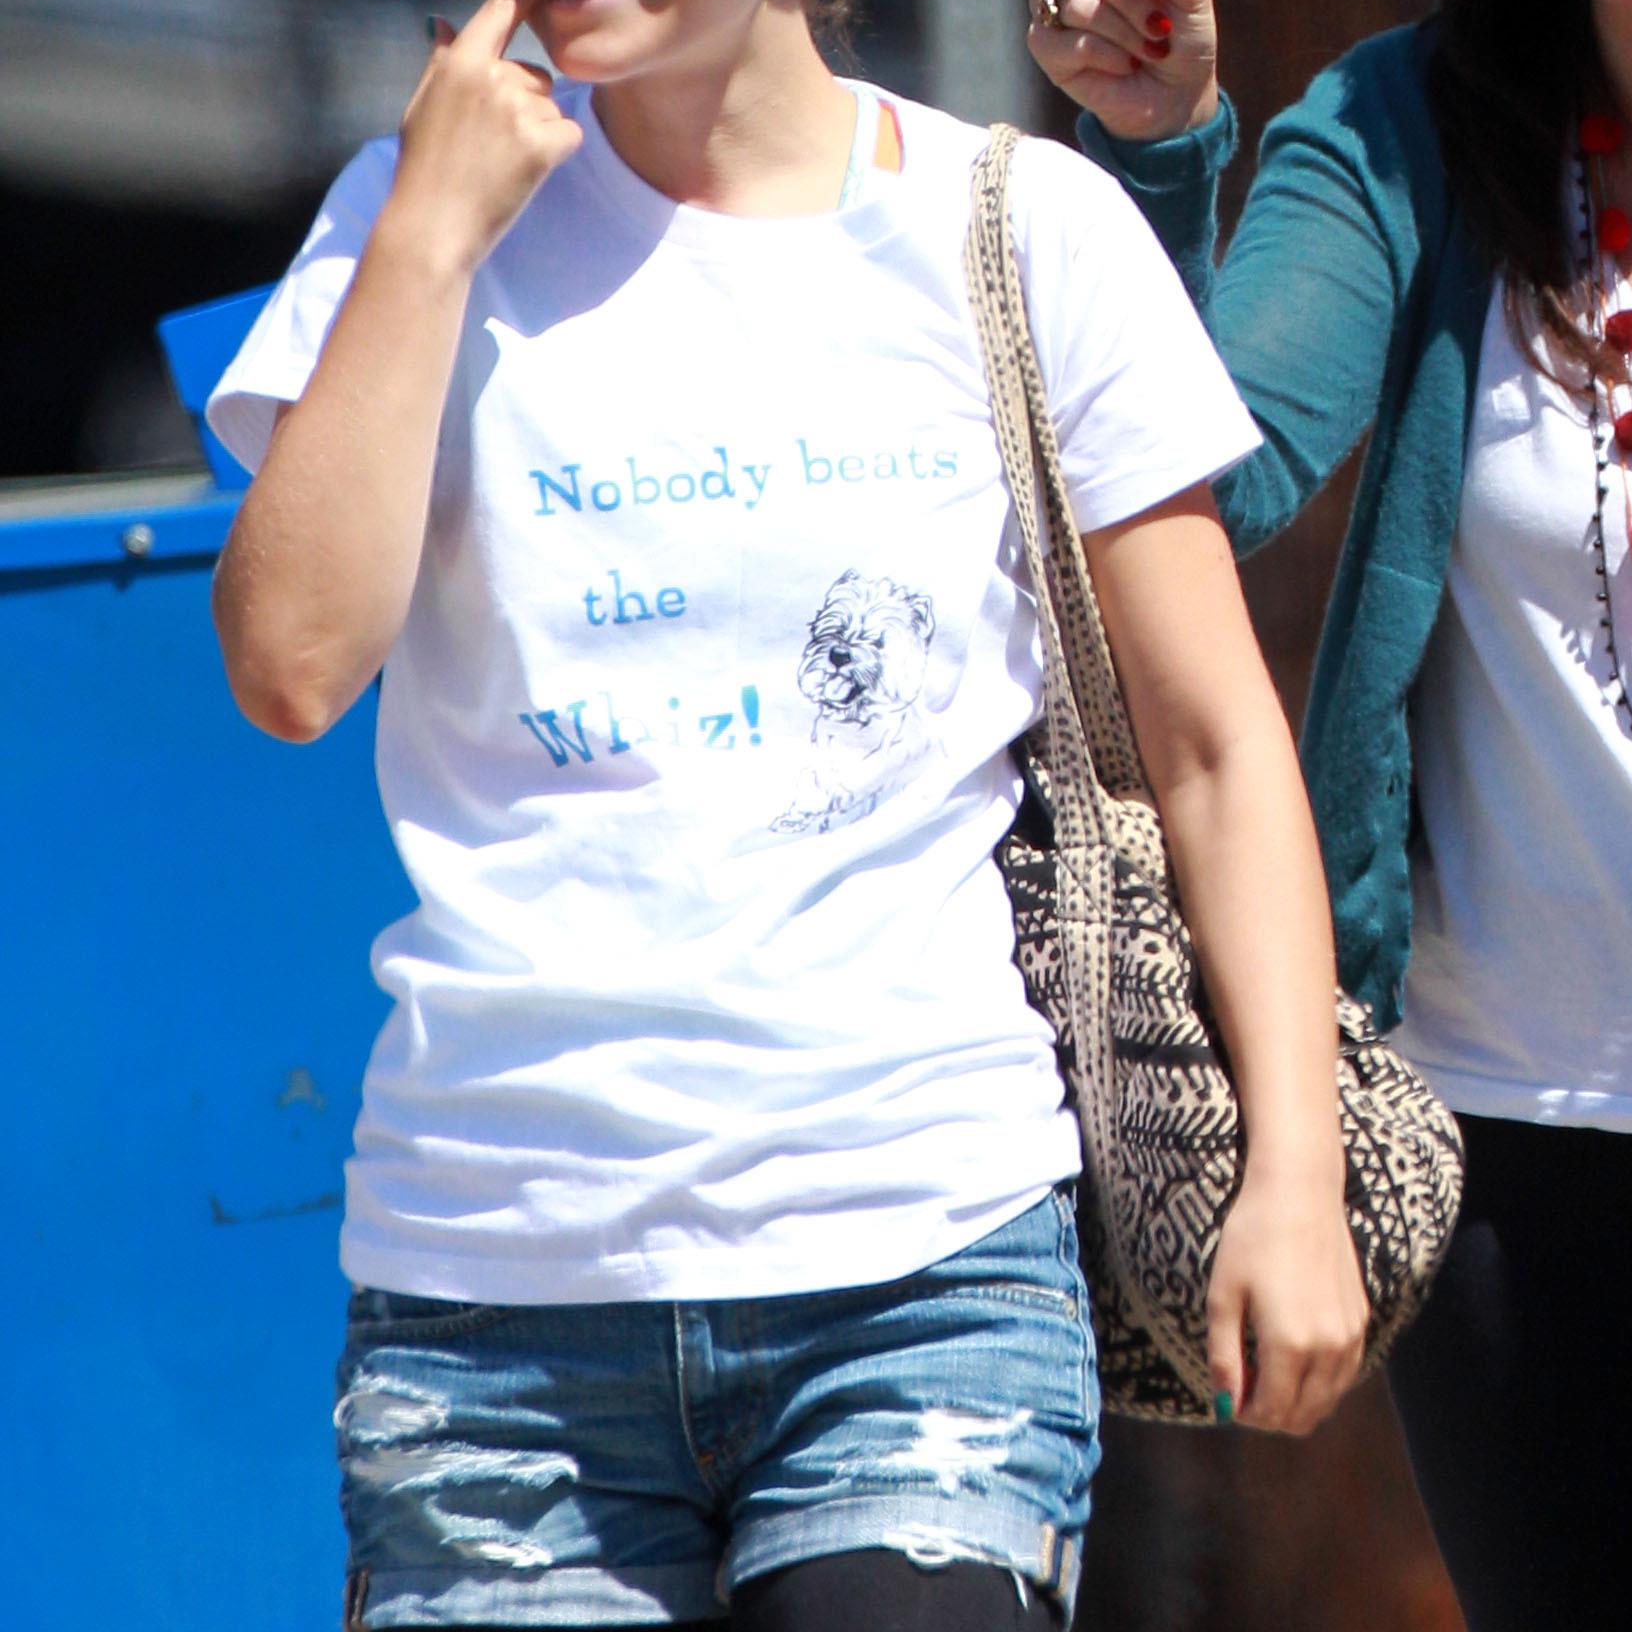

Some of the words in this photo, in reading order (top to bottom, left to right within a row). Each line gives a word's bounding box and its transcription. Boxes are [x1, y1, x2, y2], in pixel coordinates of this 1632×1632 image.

[529, 447, 772, 515] Nobody
[797, 438, 958, 485] beats
[583, 570, 686, 625] the
[519, 685, 762, 767] Whiz!
